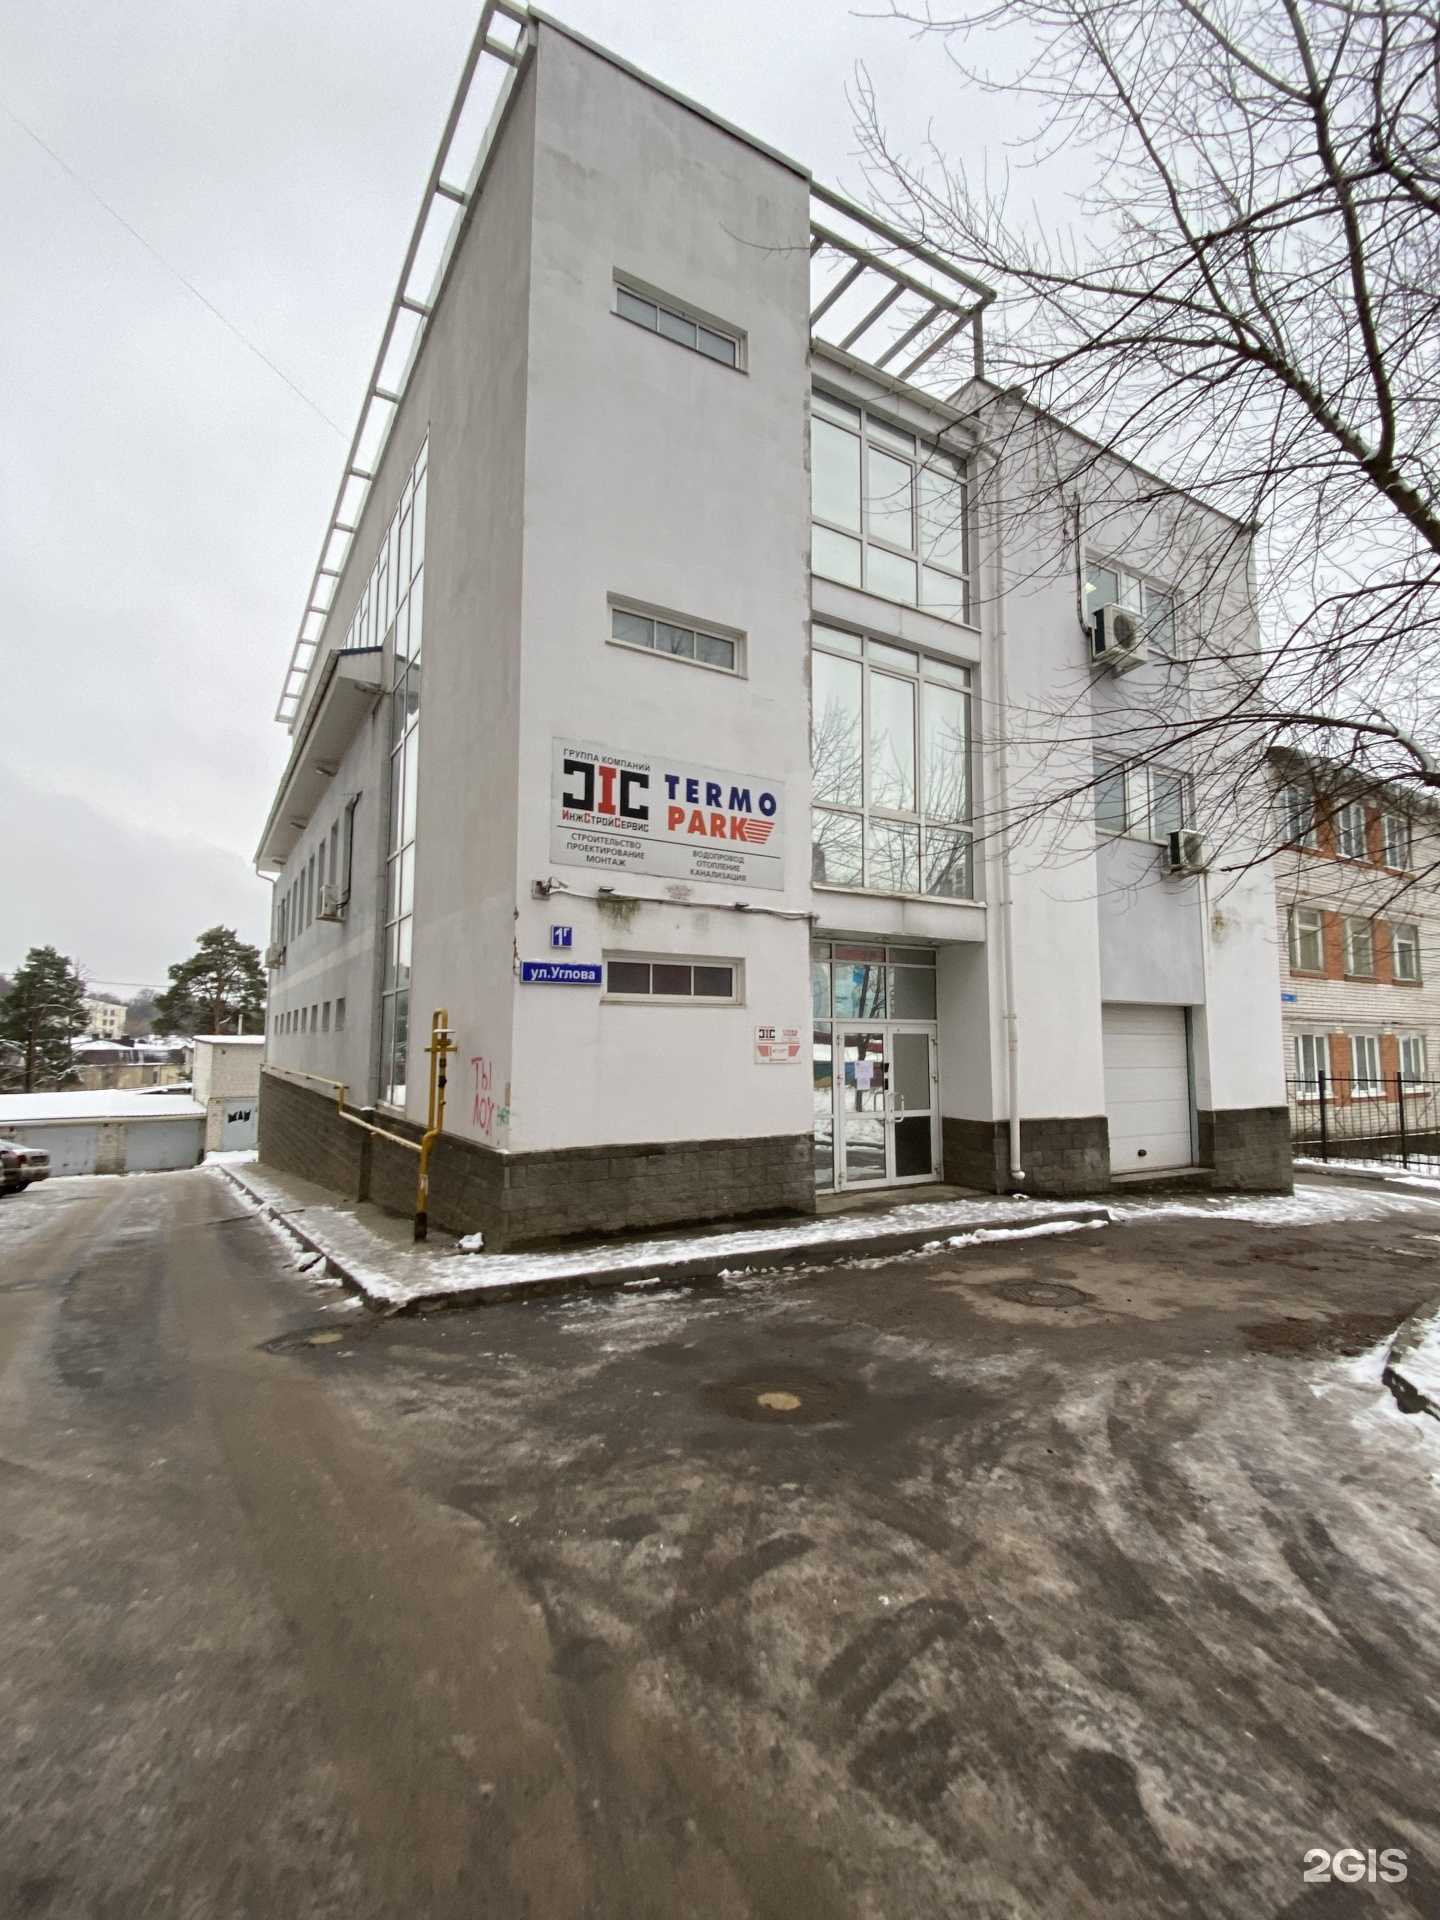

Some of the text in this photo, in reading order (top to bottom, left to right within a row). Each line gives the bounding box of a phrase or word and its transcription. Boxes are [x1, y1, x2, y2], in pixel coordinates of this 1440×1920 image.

[563, 748, 651, 772] ГРУППА КОМПАНИЙ
[664, 774, 777, 817] TERMO
[667, 805, 748, 842] PARK
[571, 832, 642, 849] СТРОИТЕЛЬСТВО
[566, 842, 645, 860] ПРОЕКТИРОВАНИЕ
[692, 850, 745, 865] ВОДОПРОВОД
[586, 855, 626, 867] МОНТАЖ
[696, 860, 740, 873] ОТОПЛЕНИЕ
[690, 869, 747, 882] КАНАЛИЗАЦИЯ
[530, 966, 596, 981] ул.Углова
